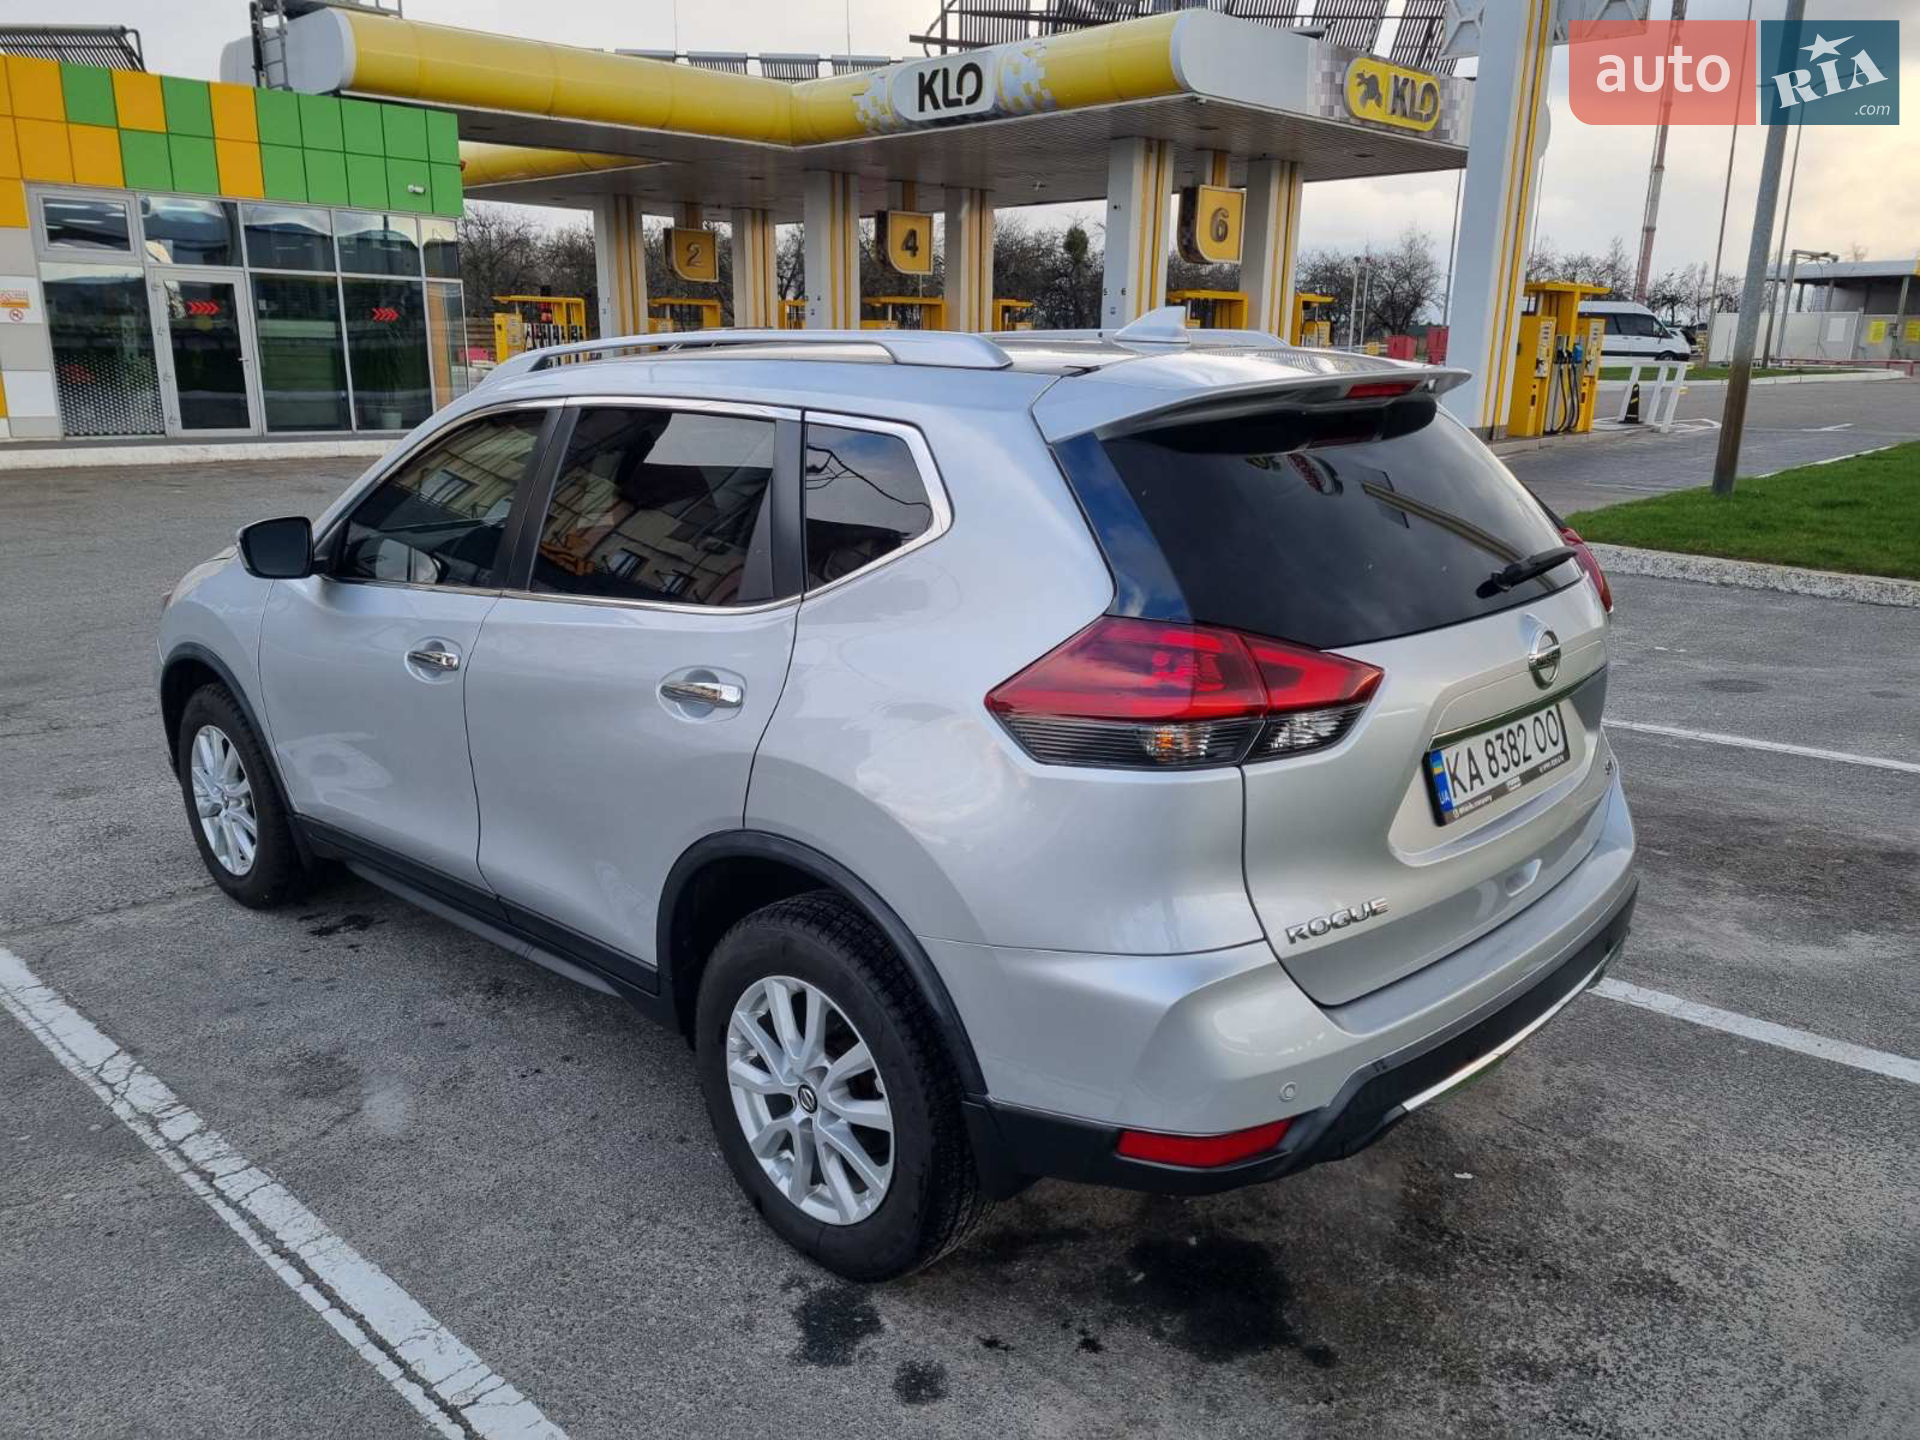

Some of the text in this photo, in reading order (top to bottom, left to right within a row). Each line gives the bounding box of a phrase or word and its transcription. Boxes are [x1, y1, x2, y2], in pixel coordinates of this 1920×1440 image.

[918, 62, 983, 113] KLO
[1387, 73, 1440, 123] KLO
[901, 229, 919, 258] 4
[1209, 207, 1229, 243] 6
[686, 243, 701, 267] 2
[1446, 747, 1485, 799] KA
[1485, 723, 1532, 778] 8382
[1438, 790, 1451, 805] UA
[1285, 898, 1389, 945] ROGUE
